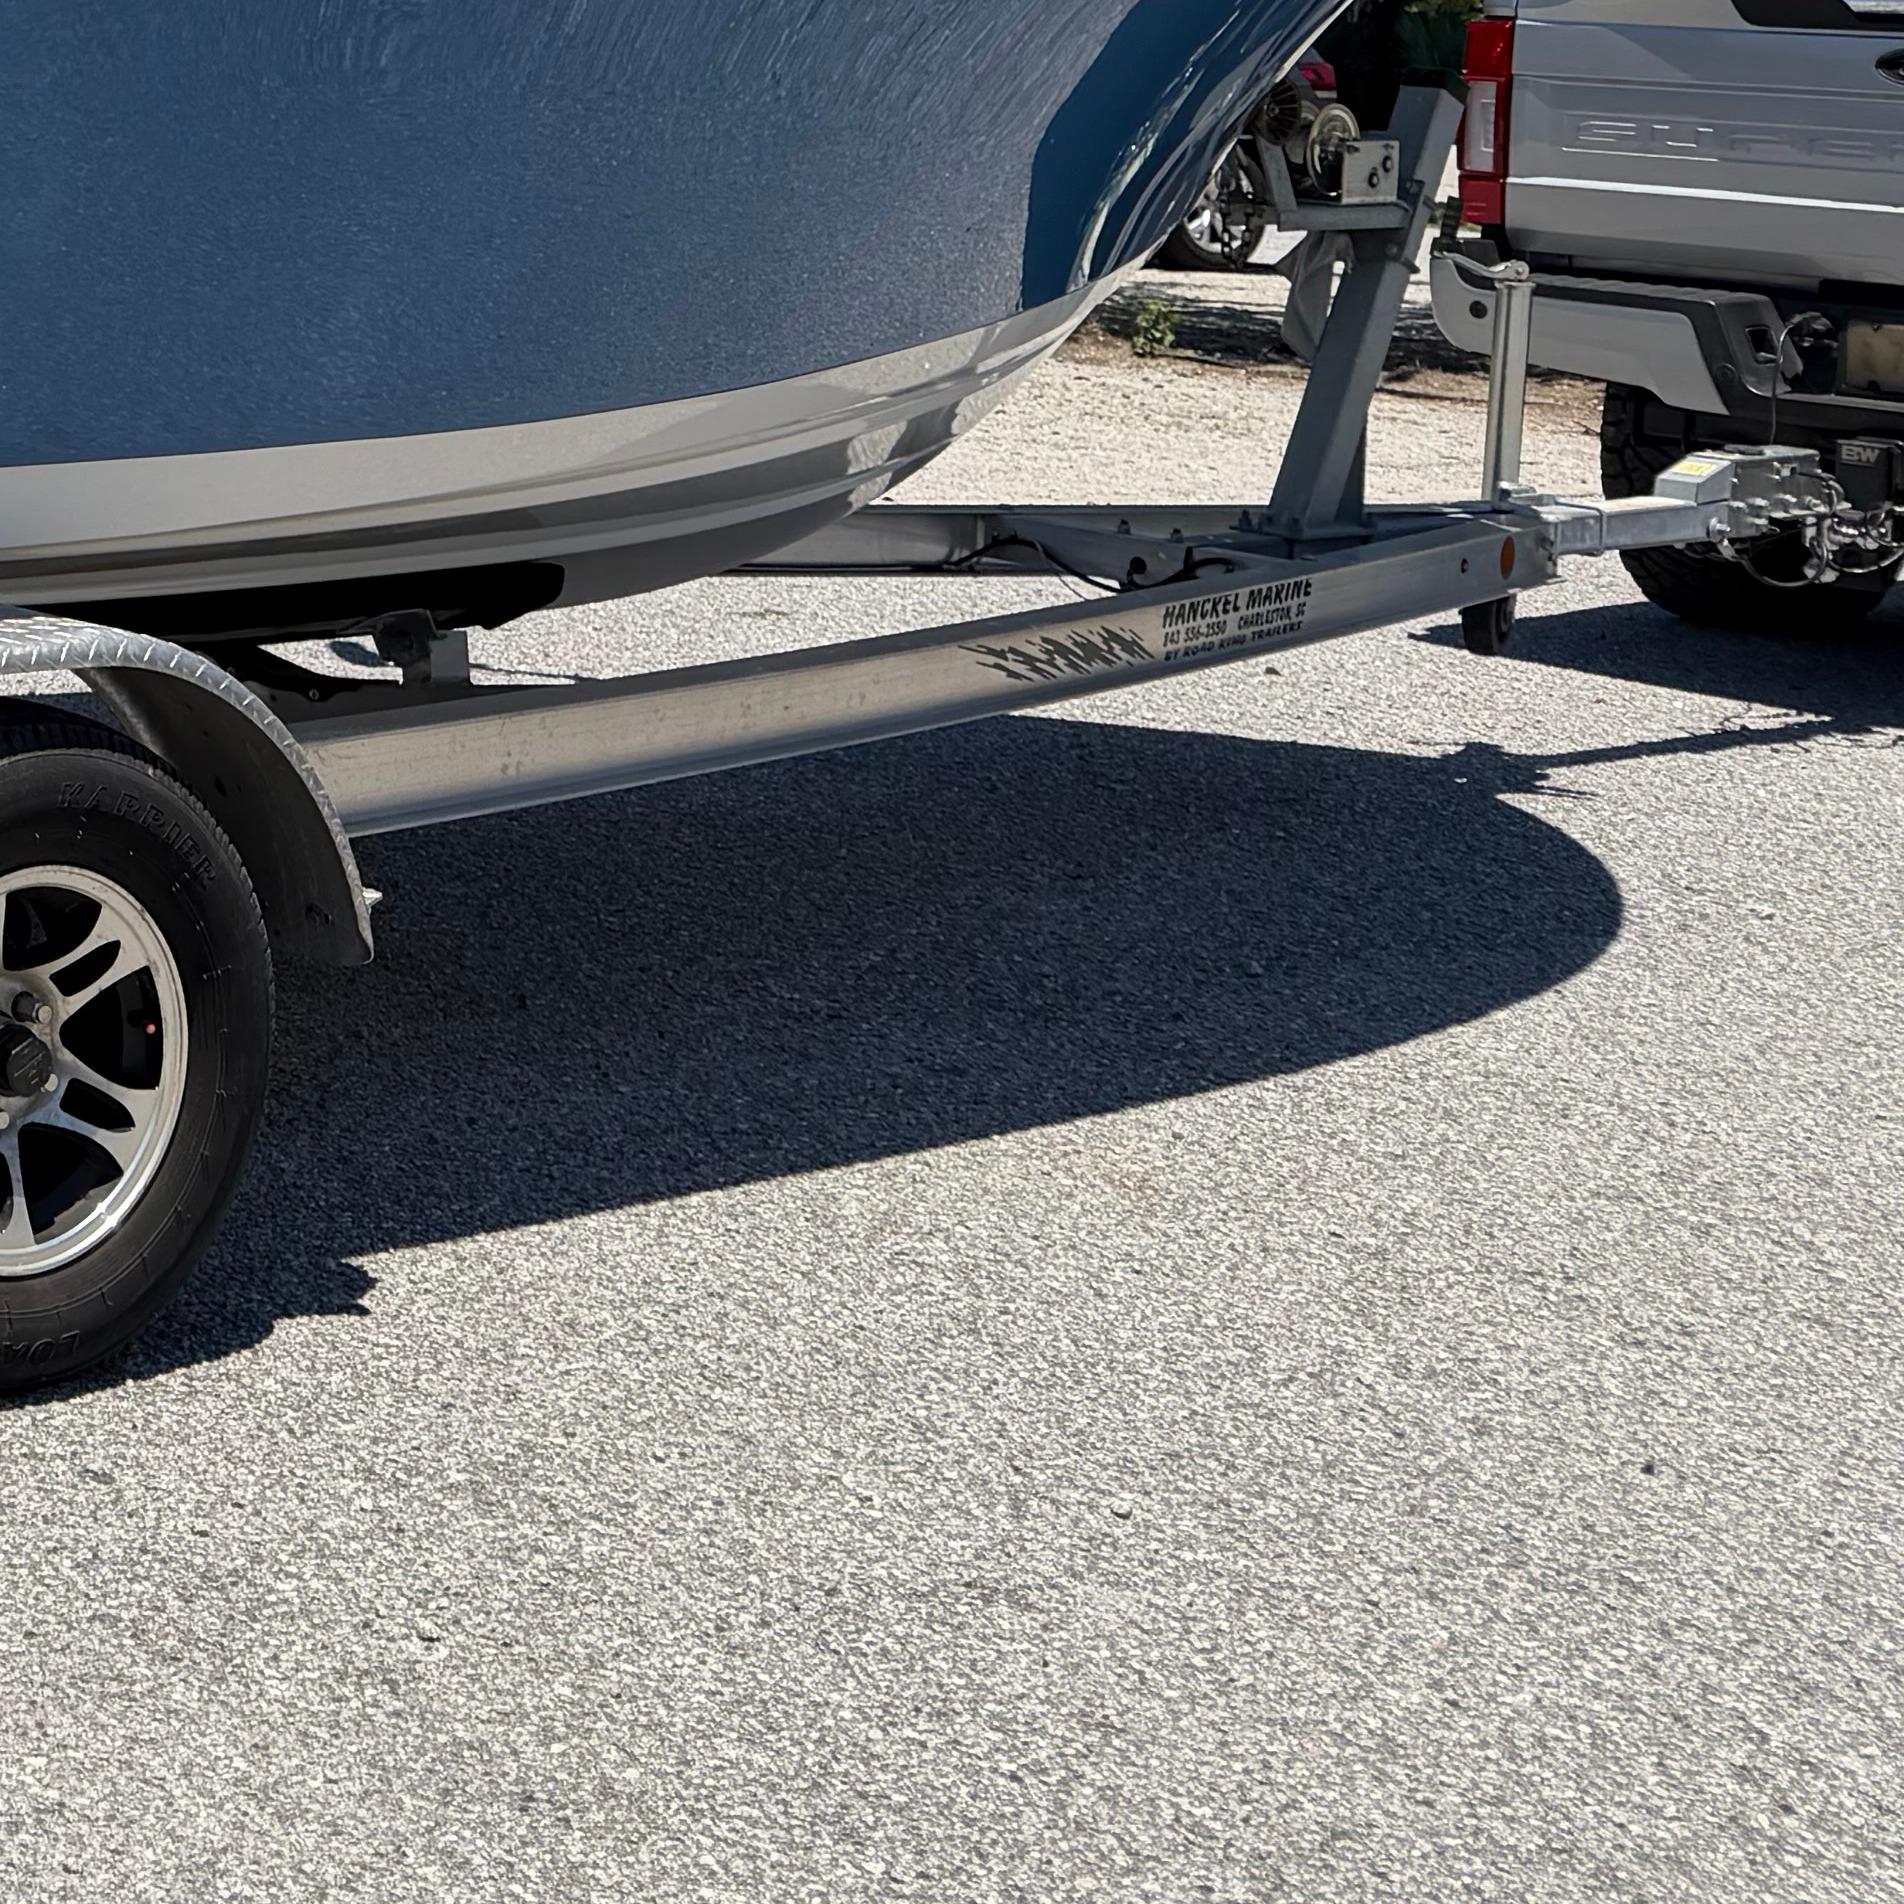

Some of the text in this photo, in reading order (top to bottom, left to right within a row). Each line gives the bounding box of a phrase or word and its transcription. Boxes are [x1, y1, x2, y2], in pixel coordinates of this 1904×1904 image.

[1577, 120, 1904, 161] SUPE
[1162, 578, 1312, 628] HANCKEL MARINE
[1251, 620, 1304, 643] TRAILERS
